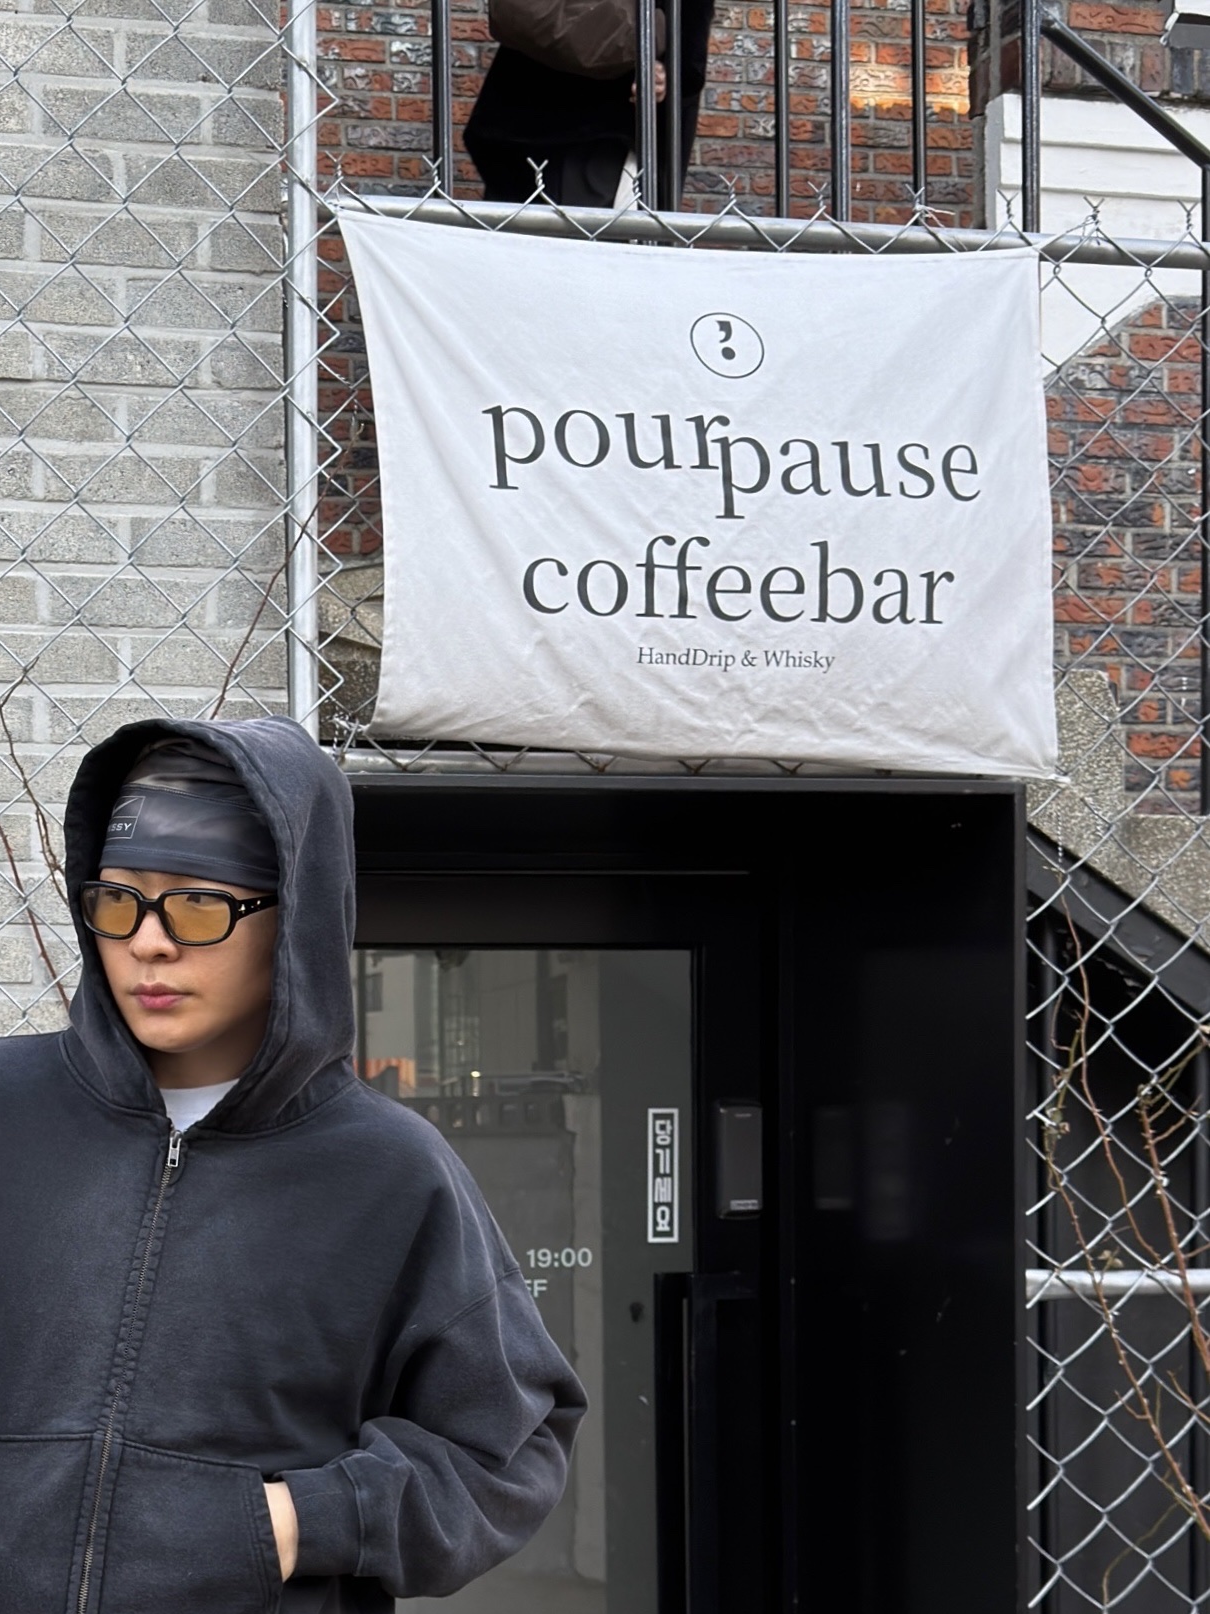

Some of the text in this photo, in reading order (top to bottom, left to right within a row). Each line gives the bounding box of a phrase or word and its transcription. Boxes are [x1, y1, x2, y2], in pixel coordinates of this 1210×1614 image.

[523, 535, 954, 625] coffeebar
[636, 646, 836, 674] HandDrip & Whisky
[108, 822, 132, 832] SSY
[654, 1119, 672, 1232] 당기세요
[526, 1247, 593, 1268] 19:00
